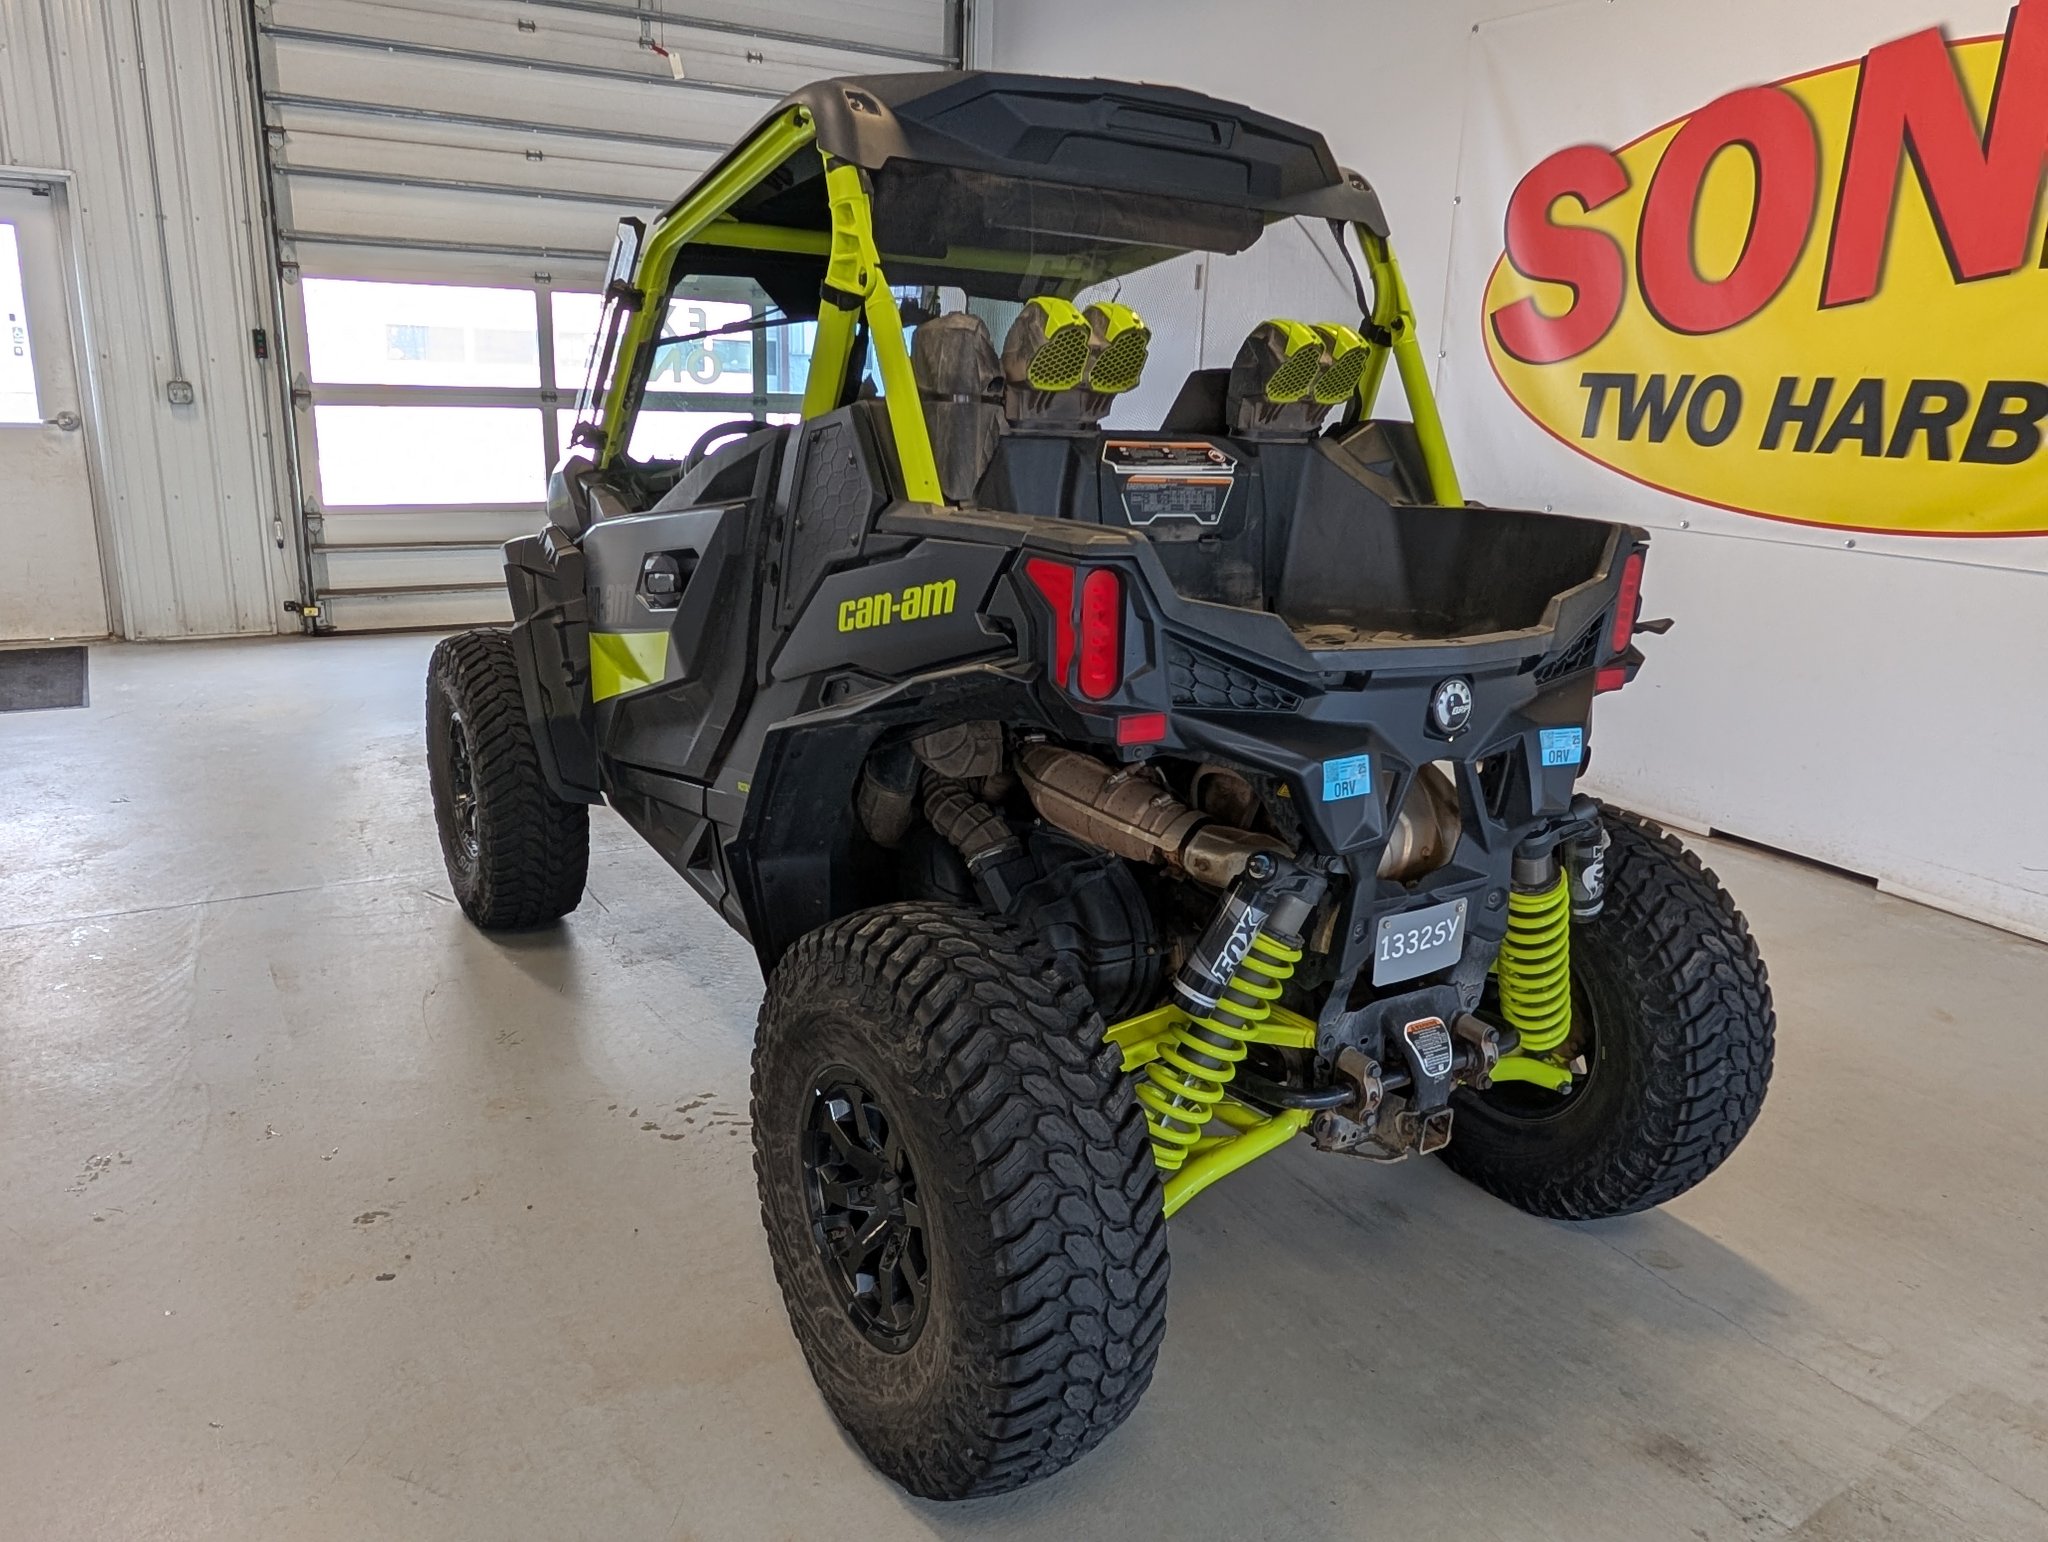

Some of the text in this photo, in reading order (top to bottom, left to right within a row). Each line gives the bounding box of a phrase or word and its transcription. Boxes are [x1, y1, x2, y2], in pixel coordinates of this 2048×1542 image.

[1490, 0, 2048, 364] SON
[1580, 373, 2048, 465] TWO HARB
[839, 579, 956, 632] can-am
[1548, 749, 1570, 764] ORV
[1334, 780, 1356, 798] ORV
[1211, 905, 1269, 986] FOX
[1380, 915, 1460, 961] 1332SY
